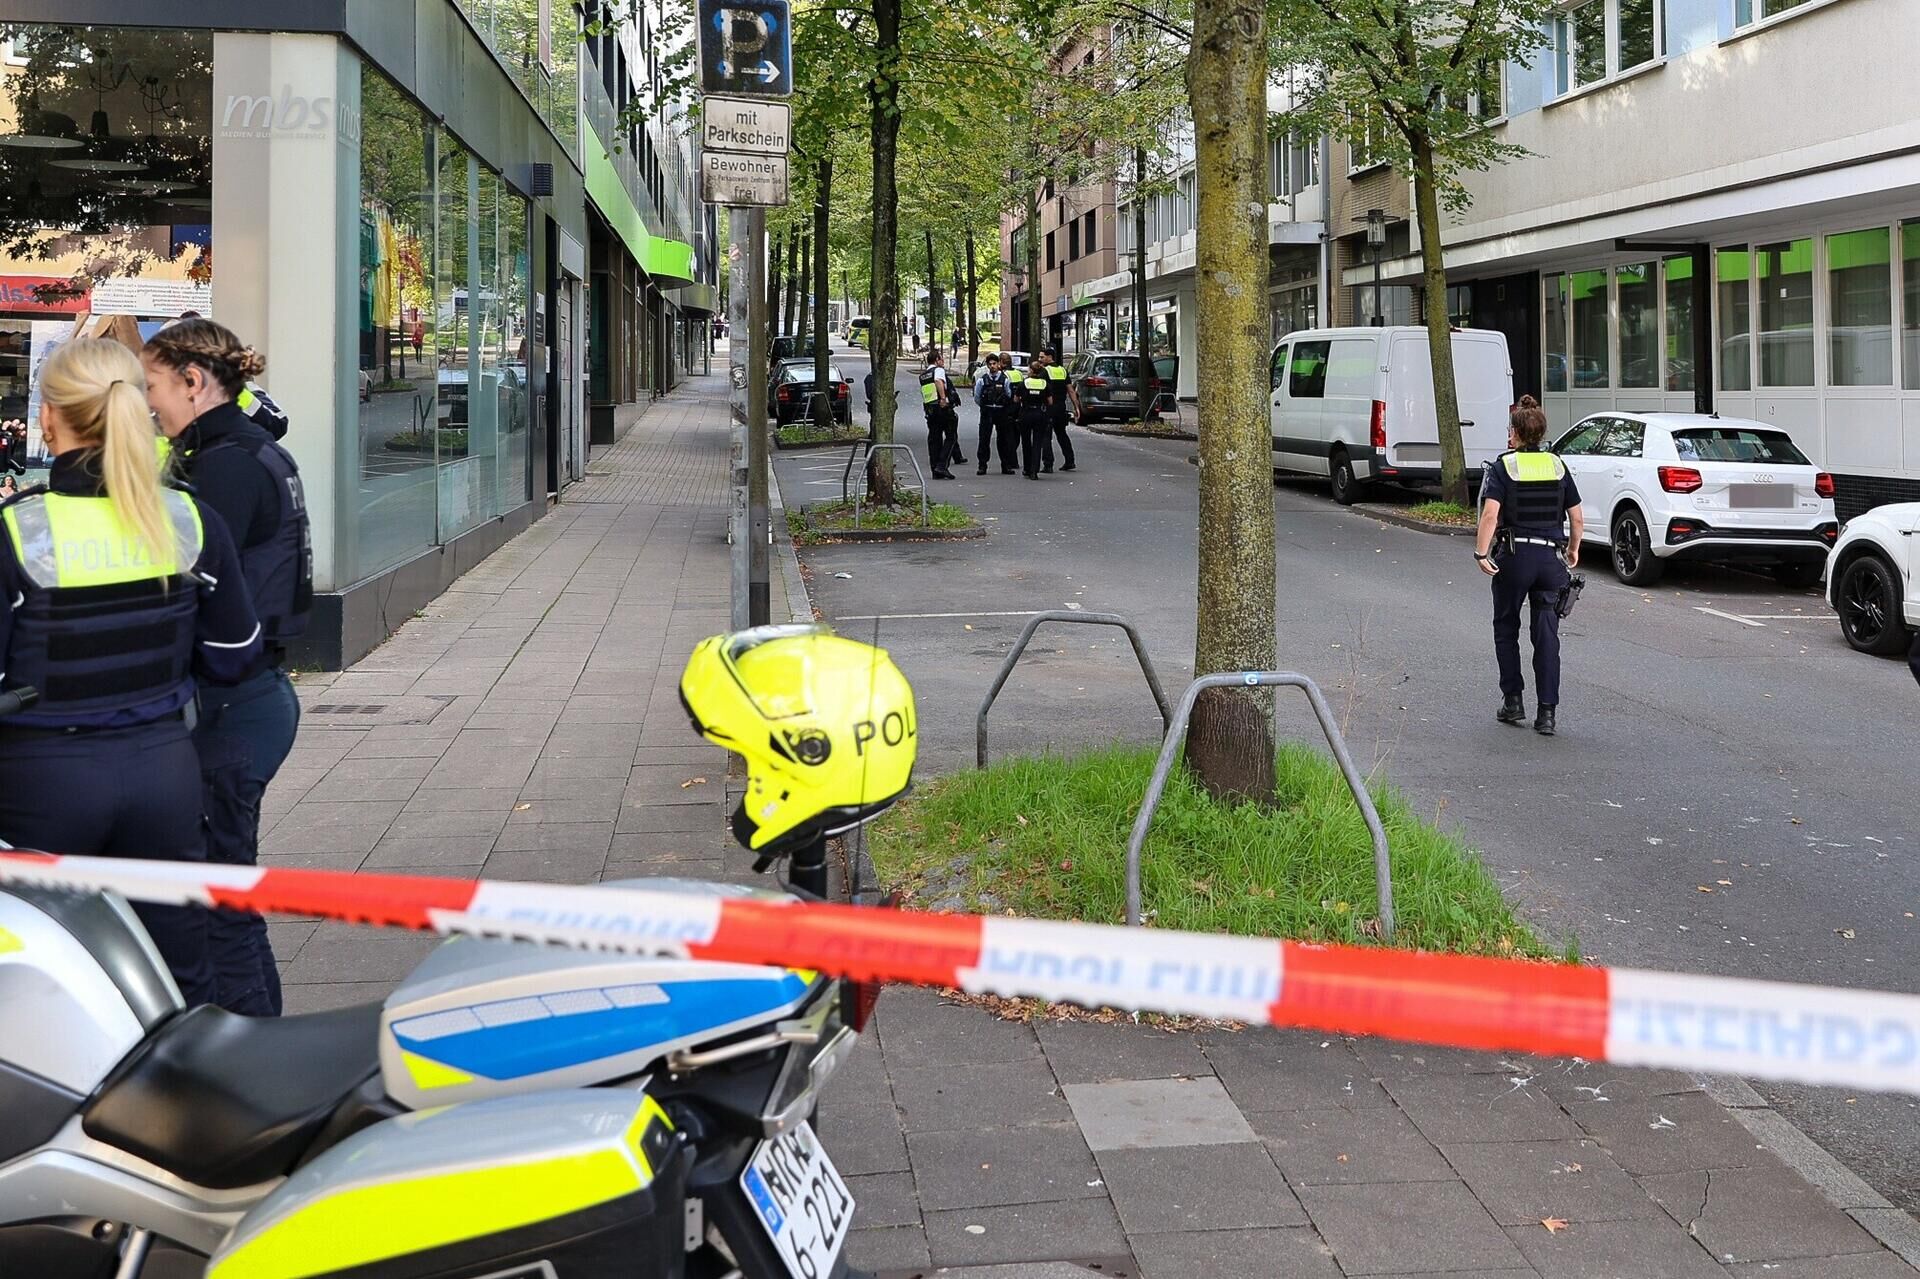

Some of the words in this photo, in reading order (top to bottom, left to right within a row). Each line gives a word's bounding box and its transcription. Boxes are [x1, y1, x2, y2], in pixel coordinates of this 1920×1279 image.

[721, 9, 768, 79] P
[221, 83, 331, 130] mbs
[736, 110, 757, 125] mit
[708, 125, 784, 147] Parkschein
[710, 157, 777, 173] Bewohner
[734, 186, 757, 199] frei
[62, 537, 165, 574] POLIZ
[1245, 673, 1258, 685] G
[853, 706, 916, 757] POL
[789, 1159, 849, 1279] 6-221
